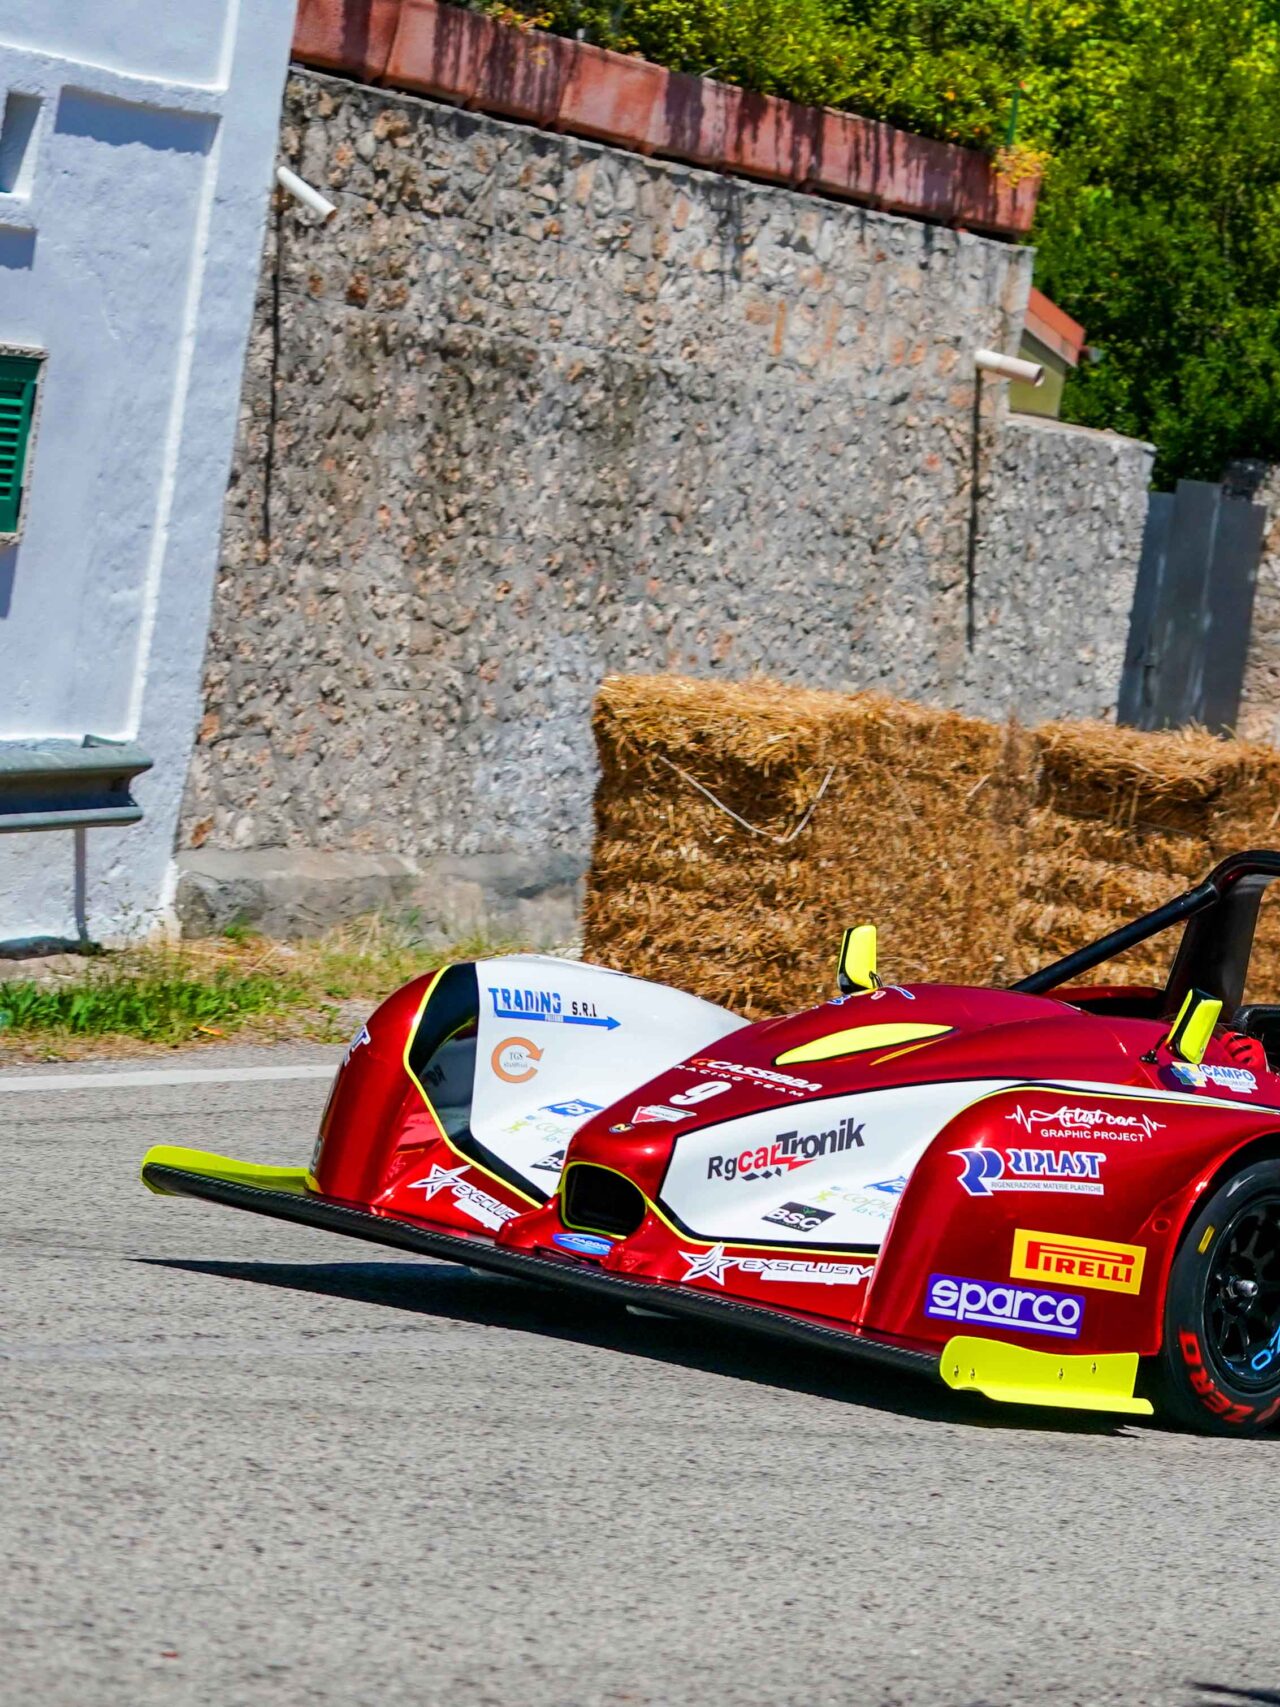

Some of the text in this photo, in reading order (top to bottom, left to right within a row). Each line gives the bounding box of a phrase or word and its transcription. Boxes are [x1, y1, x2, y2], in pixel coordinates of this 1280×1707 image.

[488, 987, 562, 1014] TRADING
[1200, 1065, 1255, 1082] CAMPO
[669, 1080, 732, 1106] 9
[752, 1080, 805, 1097] TEAM
[1040, 1128, 1145, 1142] GRAPHIC PROJECT
[1006, 1149, 1105, 1178] RIPLAST
[1070, 1184, 1102, 1192] PLASTICHE
[766, 1208, 822, 1230] BSC
[742, 1259, 874, 1276] EXSCLUSIV
[1025, 1240, 1135, 1283] PIRELLI
[930, 1279, 1080, 1327] sparco
